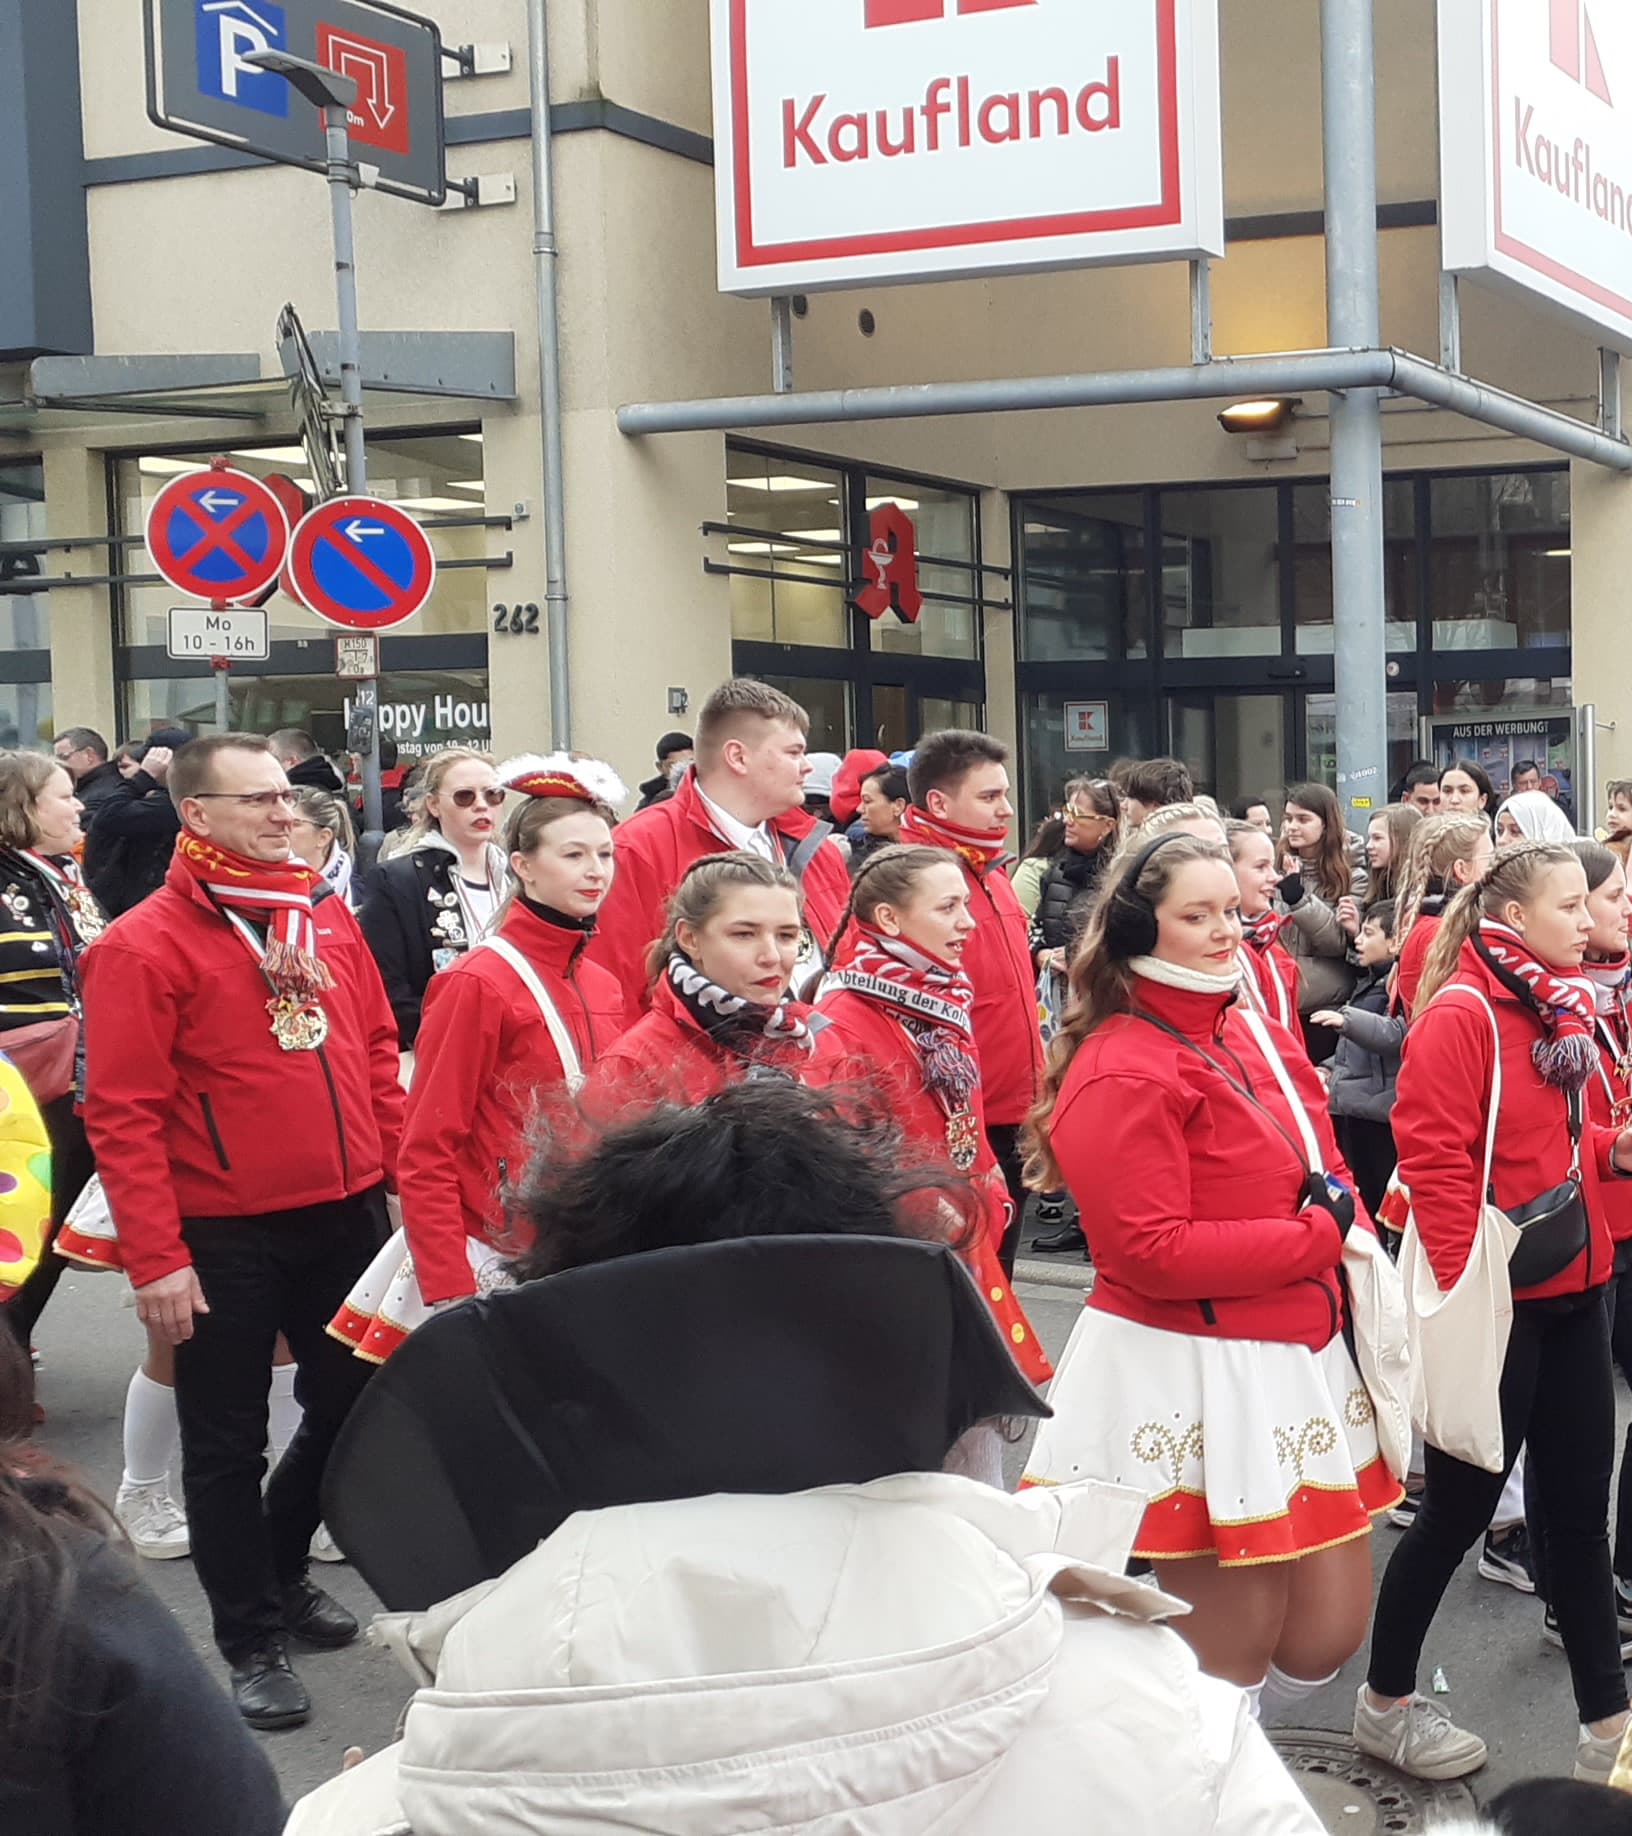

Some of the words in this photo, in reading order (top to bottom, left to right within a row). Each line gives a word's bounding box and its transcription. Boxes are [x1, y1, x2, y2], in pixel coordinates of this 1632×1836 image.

[782, 55, 1121, 169] Kaufland
[205, 616, 232, 631] Mo
[493, 603, 540, 635] 262
[184, 634, 202, 650] 10
[225, 636, 255, 651] 16h
[344, 697, 426, 737] Hppy
[434, 695, 488, 729] Hou
[1452, 725, 1472, 738] AUS
[1474, 723, 1493, 737] DER
[912, 991, 939, 1010] der
